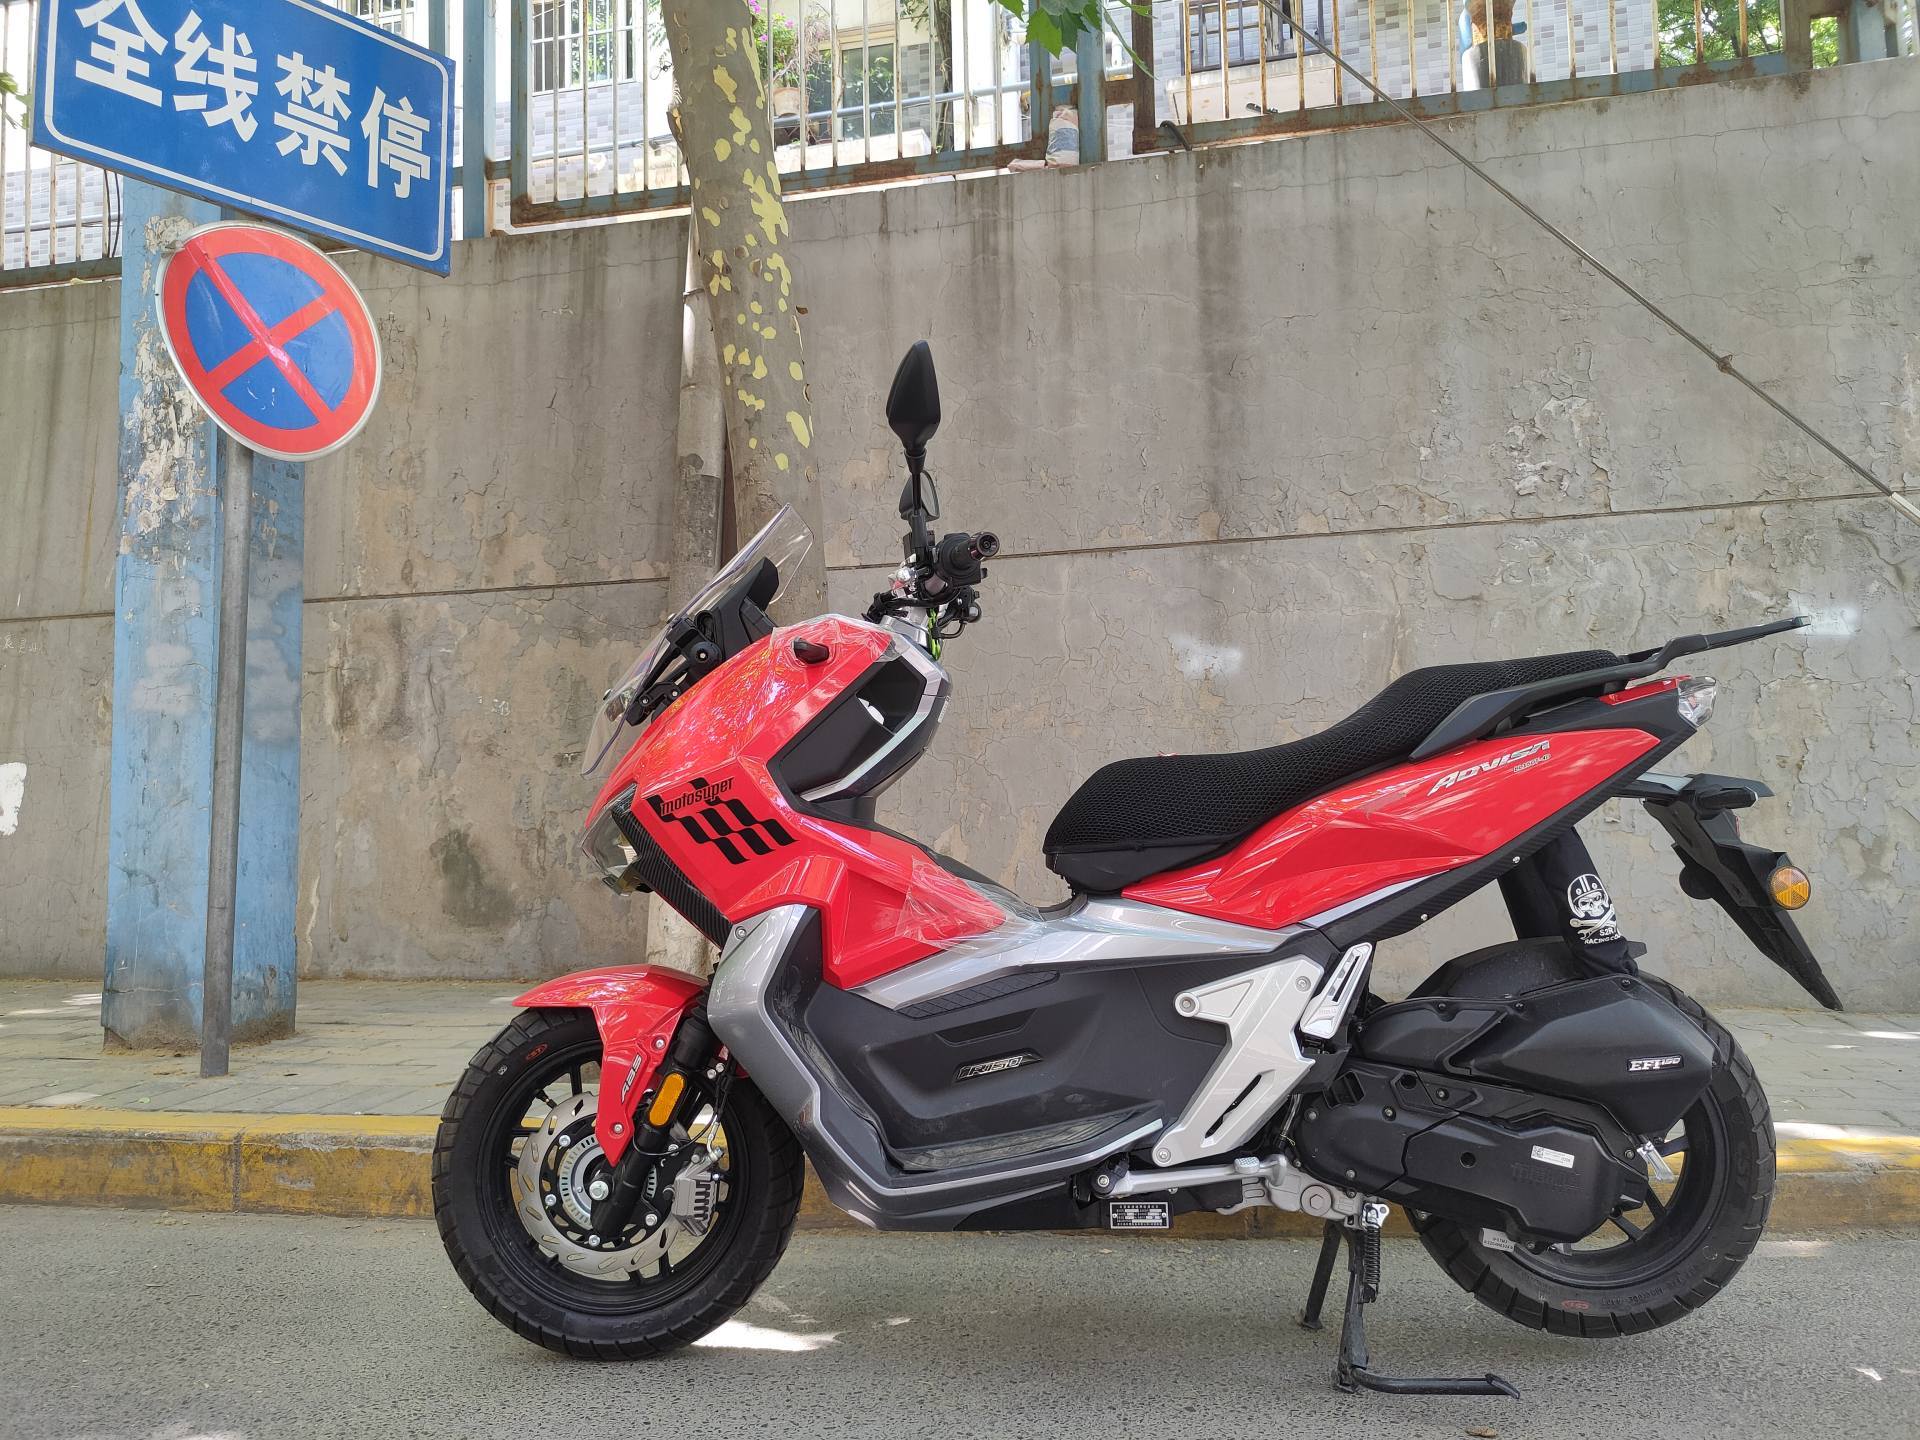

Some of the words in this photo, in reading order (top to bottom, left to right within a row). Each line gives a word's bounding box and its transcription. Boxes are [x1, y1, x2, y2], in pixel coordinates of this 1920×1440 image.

[75, 0, 432, 199] 全线禁停
[660, 777, 735, 817] motosuper
[1584, 937, 1609, 945] RACING
[1599, 927, 1614, 937] S2R
[621, 1054, 642, 1103] ABS
[1628, 1060, 1661, 1072] EFI
